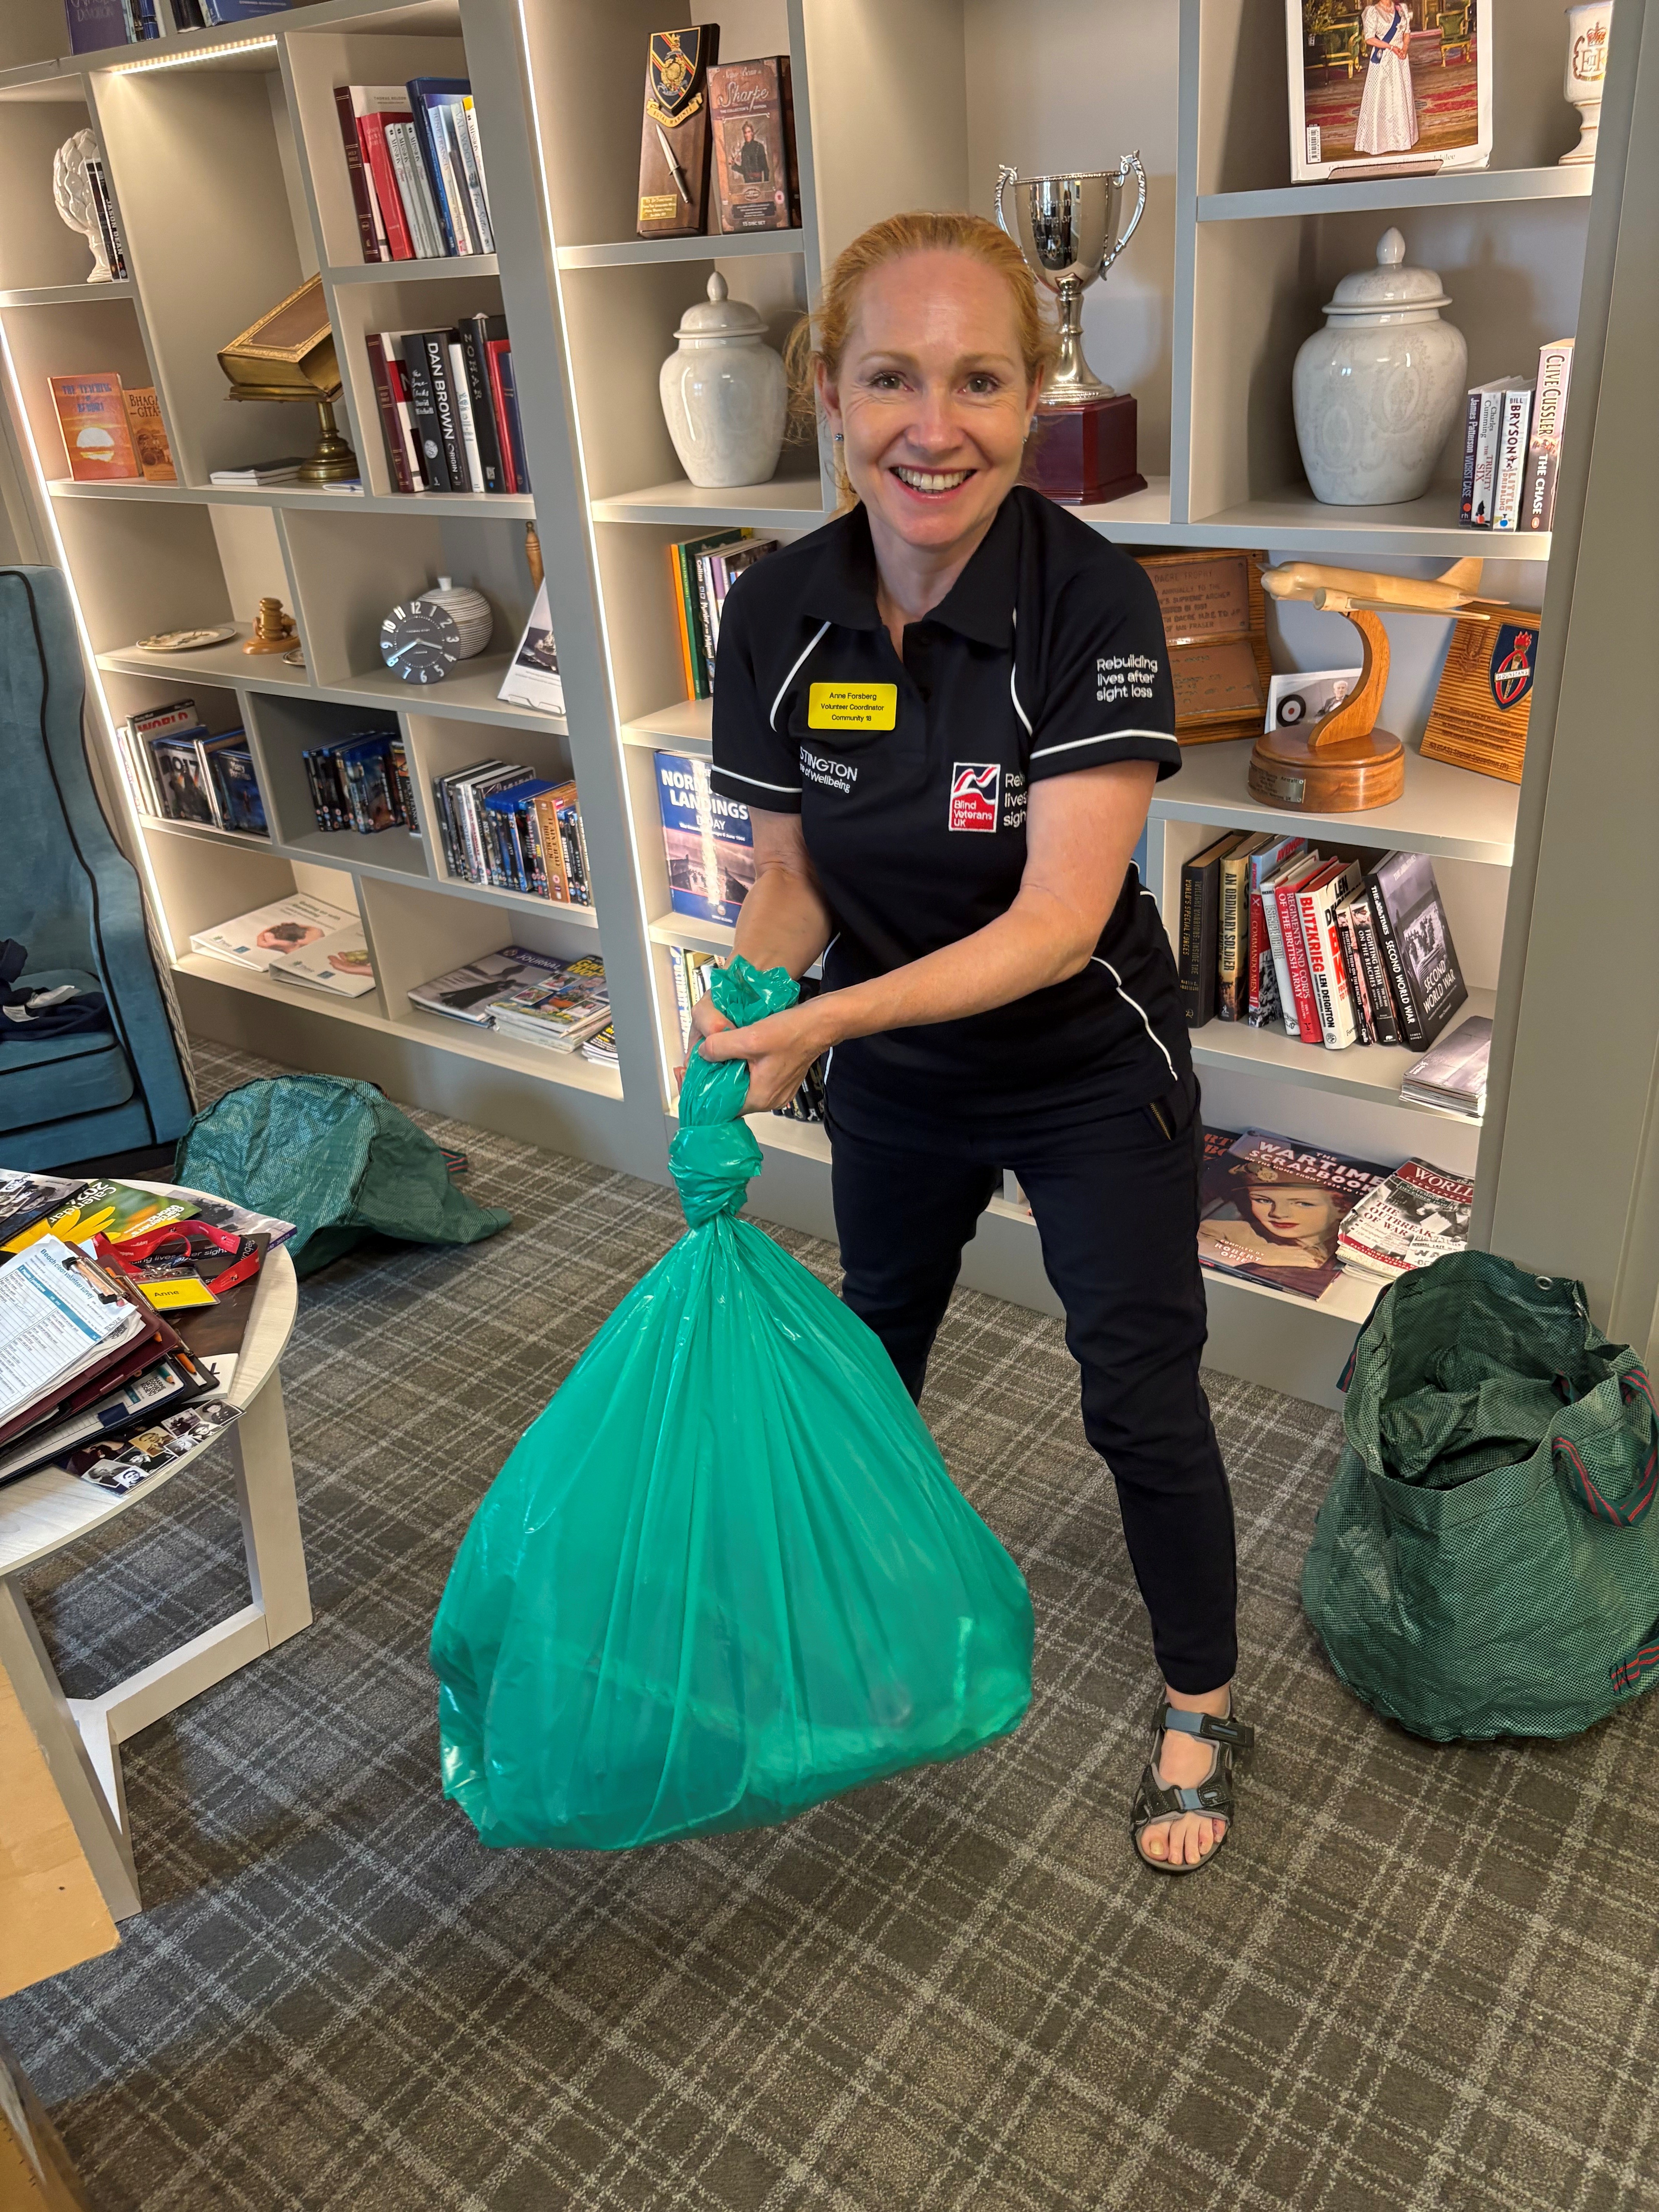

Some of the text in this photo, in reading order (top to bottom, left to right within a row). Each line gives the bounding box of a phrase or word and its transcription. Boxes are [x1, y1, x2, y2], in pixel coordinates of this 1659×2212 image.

[718, 82, 769, 113] Sharpe
[464, 333, 482, 400] ZOHAR
[428, 343, 455, 440] DAN BROWN
[1539, 354, 1565, 437] CLIVE CUSSLER
[1470, 397, 1480, 419] James
[1480, 400, 1491, 438] Cumming
[1467, 421, 1478, 453] Patterson
[1506, 405, 1522, 454] BRYSON
[447, 443, 458, 473] ORIGIN
[1476, 464, 1485, 482] SIX
[1484, 455, 1493, 491] TRINITY
[1532, 454, 1548, 515] THE CHASE
[1462, 481, 1471, 498] CASE
[1499, 473, 1508, 511] DRIBBLING
[1505, 472, 1516, 512] LITTLE
[393, 606, 406, 620] 11
[410, 601, 421, 614] 12
[429, 606, 437, 617] 1
[382, 620, 396, 633] 10
[440, 618, 453, 628] 2
[444, 653, 457, 662] 4
[1097, 654, 1158, 673] Rebuilding
[403, 666, 411, 679] 7
[420, 670, 428, 683] 6
[434, 665, 444, 677] 5
[1097, 670, 1155, 687] lives after
[847, 693, 877, 701] Forsberg
[1096, 684, 1152, 702] sight loss
[800, 746, 858, 781] STINGTON
[810, 771, 851, 794] Wellbeing
[670, 789, 749, 820] LANDINGS
[953, 809, 993, 820] Veterans
[954, 800, 977, 810] Blind
[953, 818, 966, 827] UK
[561, 837, 569, 862] DARKEST
[1223, 873, 1237, 971] AN ORDINARY SOLDIER
[1371, 885, 1389, 936] THE TIMES
[1249, 920, 1258, 972] COMMANDO
[1279, 893, 1303, 999] OF THE BRITISH ARMY
[1287, 893, 1310, 999] REGIMENTS AND CORPS
[1300, 897, 1324, 973] BLITZKRIEG
[516, 954, 562, 970] JOURNAL
[1358, 930, 1365, 941] ON
[1365, 957, 1376, 988] BEACHES
[1365, 929, 1382, 985] FIGHTING THEM
[1318, 974, 1327, 988] LEN
[1386, 940, 1415, 1024] SECOND WORLD WAR
[1424, 960, 1446, 994] SECOND
[1423, 983, 1444, 1015] WORLD
[1443, 969, 1456, 990] WAR
[1321, 990, 1336, 1028] DEIGHTON
[1259, 1141, 1386, 1187] WARTIME
[1316, 1152, 1338, 1161] THE
[1249, 1150, 1376, 1191] SCRAPBOOK
[1255, 1159, 1271, 1167] THE
[1273, 1164, 1293, 1174] HOME
[1295, 1172, 1321, 1182] FRONT
[1406, 1176, 1467, 1202] EYEWITNESS
[49, 1187, 117, 1223] Calendar
[147, 1205, 180, 1222] World
[1376, 1200, 1400, 1216] THE
[1364, 1212, 1408, 1236] OF WAR
[1369, 1207, 1432, 1238] OUTBREAK
[1214, 1242, 1262, 1262] ROBERT
[1220, 1239, 1254, 1253] COMPILED
[1220, 1250, 1249, 1263] OPIE
[40, 1249, 94, 1300] Beach clean volunteer survey
